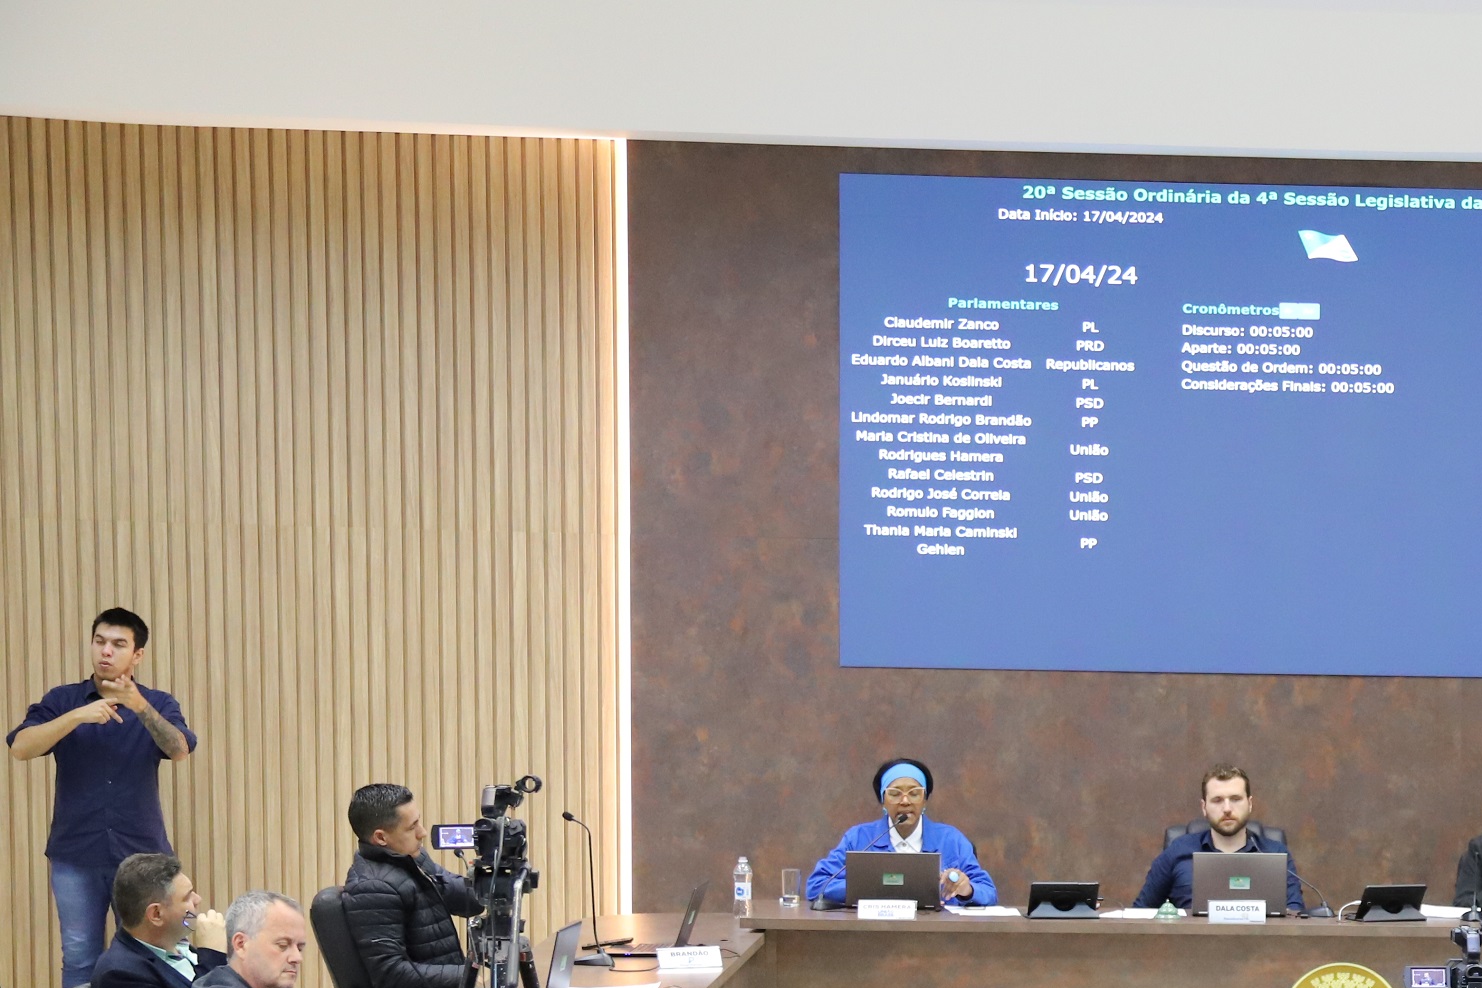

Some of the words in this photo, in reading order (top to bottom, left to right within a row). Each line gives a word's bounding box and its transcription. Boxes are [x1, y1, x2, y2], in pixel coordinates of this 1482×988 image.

[1022, 185, 1056, 200] 20ª
[1061, 186, 1129, 202] Sessão
[1133, 187, 1222, 204] Ordinária
[1227, 190, 1251, 205] da
[1255, 191, 1278, 205] 4ª
[1283, 191, 1350, 207] Sessão
[1355, 193, 1456, 211] Legislativa
[997, 207, 1032, 221] Data
[1034, 207, 1078, 222] Início:
[1083, 209, 1165, 225] 17/04/2024
[1024, 263, 1139, 288] 17/04/24
[948, 297, 1059, 311] Parlamentares
[1181, 302, 1279, 317] Cronômetros
[883, 315, 955, 330] Claudemir
[957, 317, 1000, 331] Zanco
[1081, 320, 1100, 334] PL
[1181, 323, 1245, 337] Discurso:
[1249, 325, 1314, 339] 00:05:00
[872, 334, 917, 348] Dirceu
[920, 335, 949, 349] Luiz
[951, 336, 1012, 350] Boaretto
[1075, 339, 1105, 352] PRD
[1180, 341, 1232, 356] Aparte:
[1236, 342, 1301, 356] 00:05:00
[851, 353, 909, 367] Eduardo
[911, 354, 955, 368] Albani
[958, 355, 990, 369] Dala
[992, 356, 1032, 370] Costa
[1045, 357, 1136, 373] Republicanos
[1180, 359, 1239, 374] Questão
[1240, 360, 1259, 374] de
[1261, 361, 1314, 375] Ordem:
[1317, 362, 1383, 376] 00:05:00
[880, 372, 940, 387] Januário
[942, 374, 1003, 388] Koslinski
[1081, 377, 1100, 391] PL
[1180, 377, 1279, 394] Considerações
[1281, 379, 1327, 393] Finais:
[1330, 380, 1395, 394] 00:05:00
[889, 392, 932, 406] Joecir
[933, 393, 993, 407] Bernardi
[1075, 396, 1105, 410] PSD
[850, 410, 917, 424] Lindomar
[918, 412, 972, 428] Rodrigo
[974, 413, 1033, 427] Brandão
[1081, 415, 1099, 429] PP
[855, 429, 894, 443] Maria
[896, 430, 950, 444] Cristina
[952, 431, 972, 444] de
[974, 432, 1027, 446] Oliveira
[878, 448, 947, 464] Rodrigues
[949, 450, 1004, 463] Hamera
[1069, 443, 1110, 457] União
[887, 467, 931, 481] Rafael
[933, 468, 995, 482] Celestrin
[1074, 471, 1104, 484] PSD
[870, 486, 925, 502] Rodrigo
[926, 486, 958, 500] José
[960, 488, 1011, 501] Correia
[1068, 490, 1109, 504] União
[886, 505, 939, 518] Romulo
[941, 506, 995, 521] Faggion
[1068, 508, 1109, 522] União
[863, 523, 911, 537] Thania
[913, 524, 952, 538] Maria
[954, 525, 1018, 539] Caminski
[916, 542, 965, 556] Gehlen
[1079, 536, 1098, 550] PP
[670, 950, 709, 958] BRANDÃO
